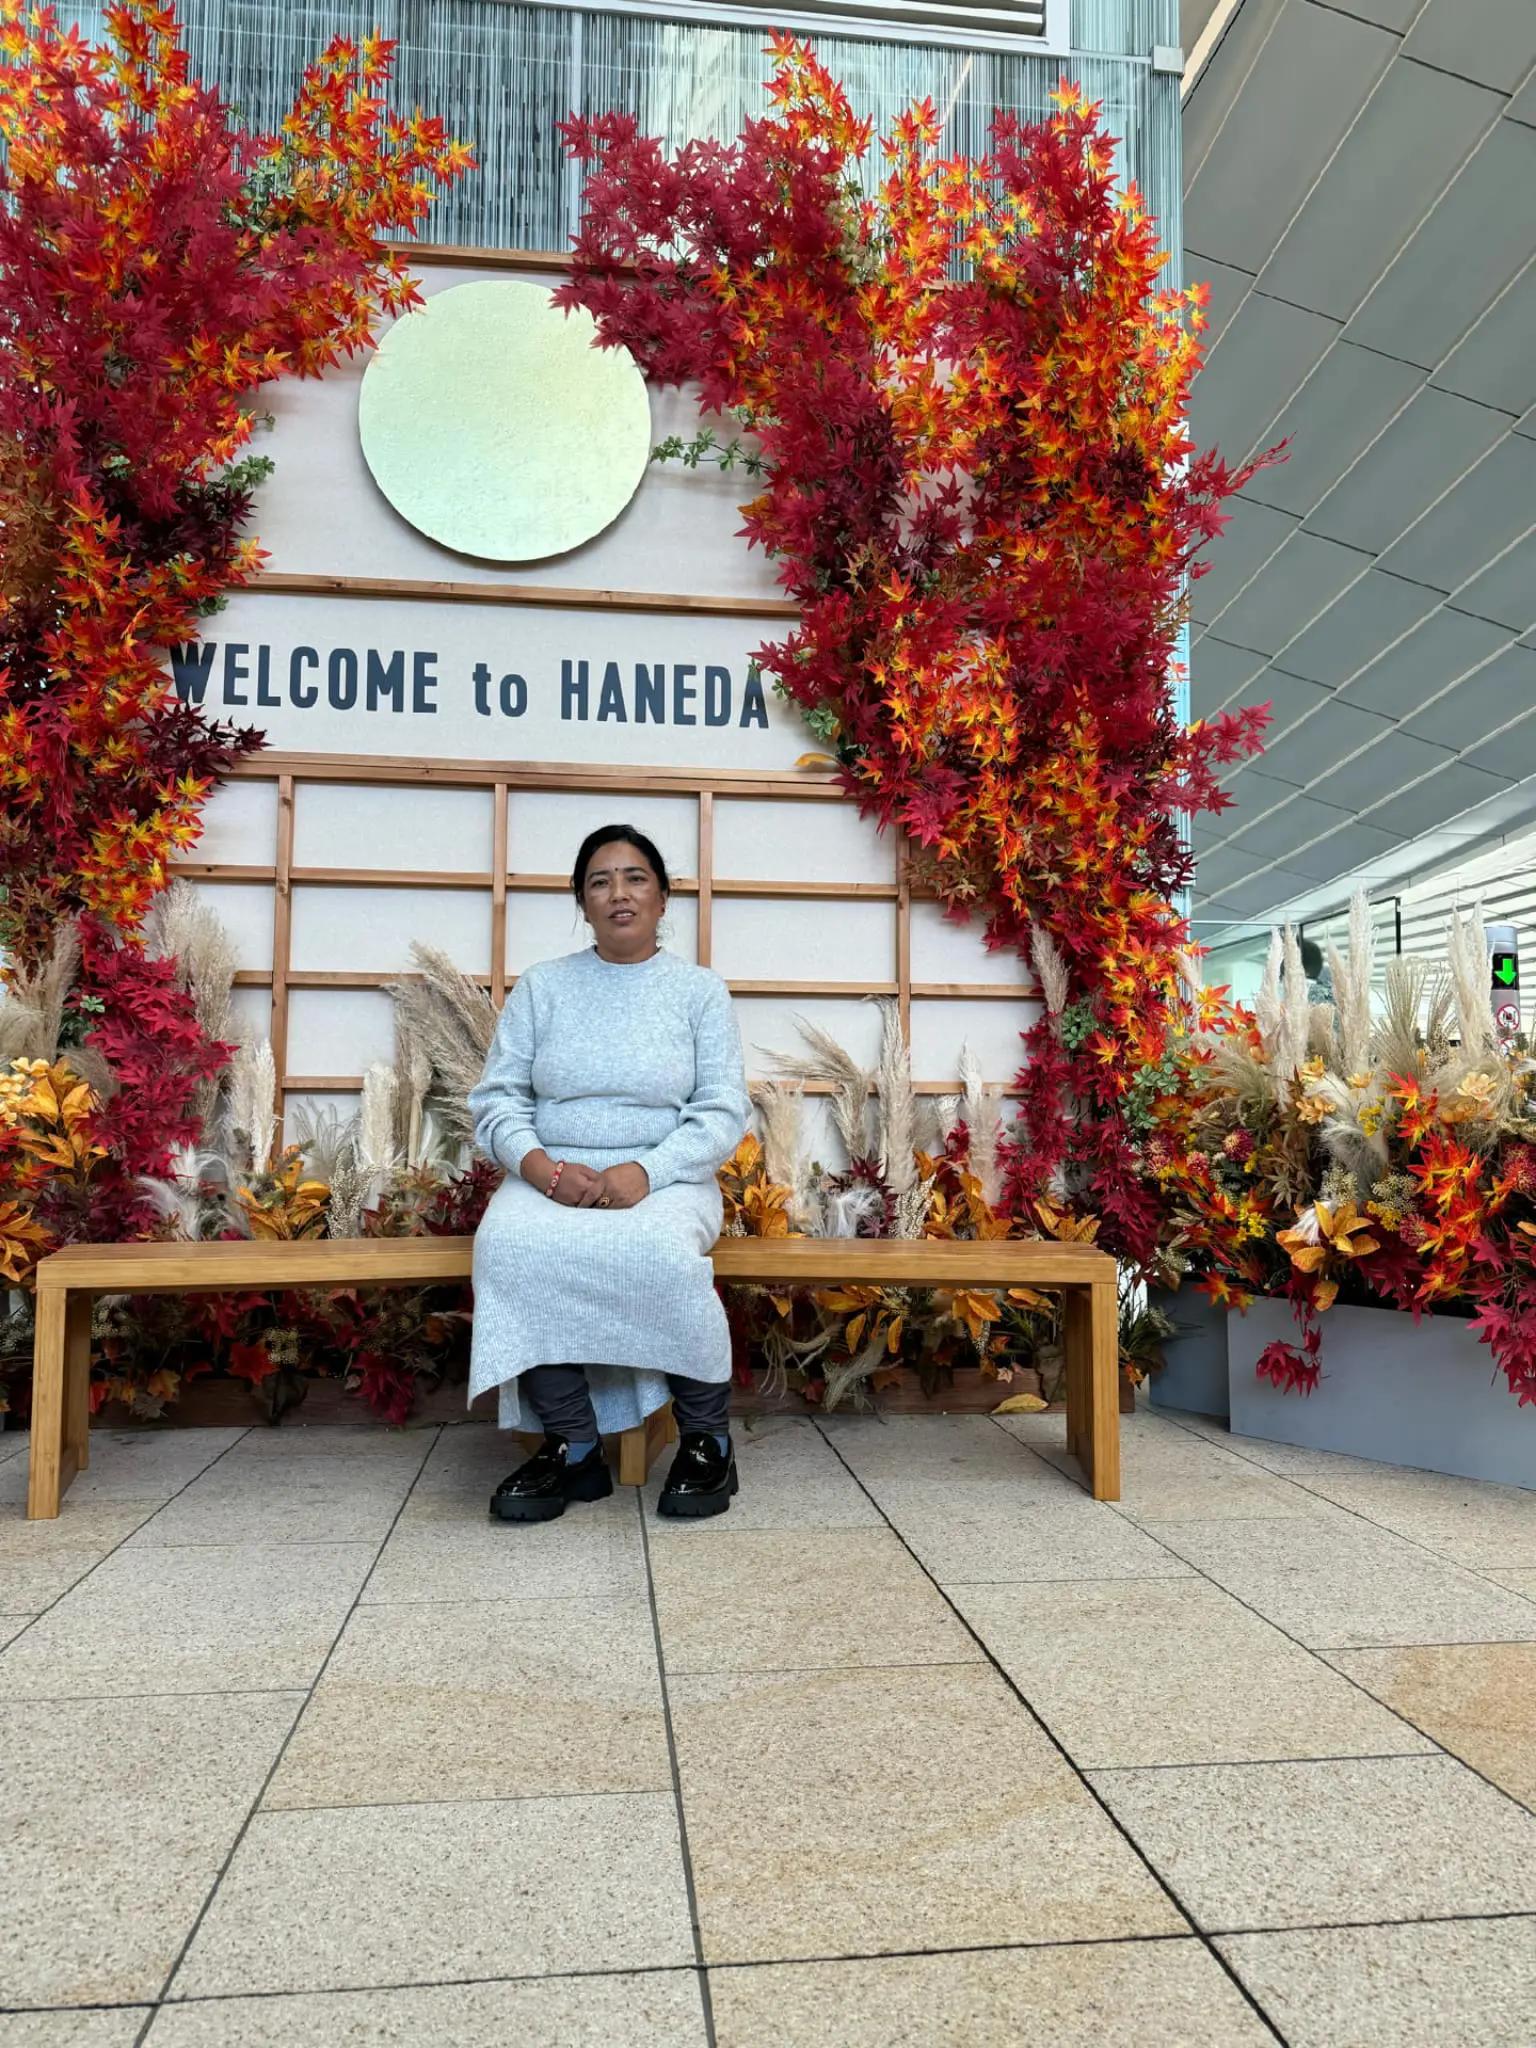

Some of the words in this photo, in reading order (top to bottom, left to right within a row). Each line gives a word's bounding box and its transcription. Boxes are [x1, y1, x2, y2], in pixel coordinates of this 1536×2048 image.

[171, 642, 438, 713] WELCOME
[472, 663, 527, 717] to
[561, 660, 769, 728] HANEDA
